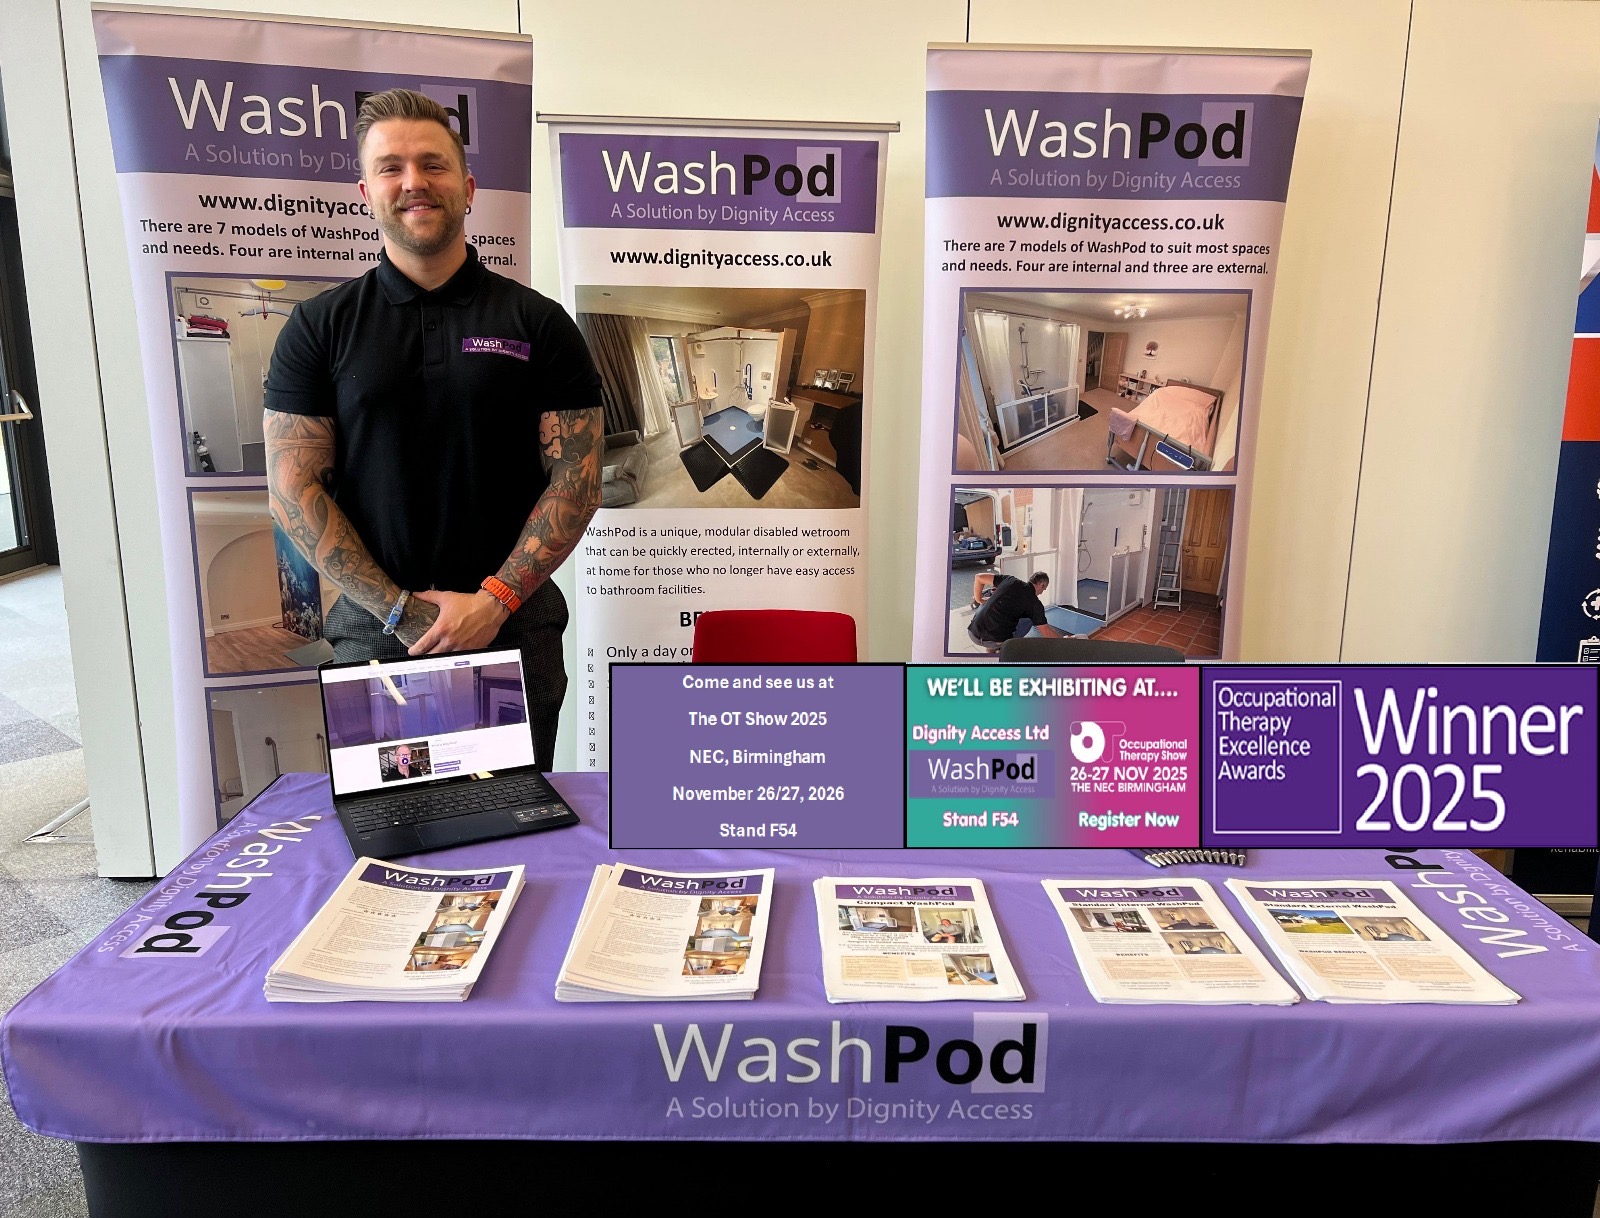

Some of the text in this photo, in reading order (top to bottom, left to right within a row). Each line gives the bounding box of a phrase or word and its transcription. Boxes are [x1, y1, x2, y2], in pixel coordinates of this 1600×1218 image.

[168, 77, 471, 145] Washd
[984, 108, 1246, 159] WashPod
[185, 144, 199, 161] A
[205, 145, 293, 168] Solution
[300, 151, 324, 173] by
[601, 150, 836, 197] WashPod
[990, 168, 1241, 193] A Solution by Dignity Access
[198, 193, 370, 218] www.dignityacc
[610, 203, 835, 226] A Solution by Dignity Access
[140, 219, 379, 241] There are 7 models of WashPod
[997, 212, 1225, 233] www.dignityaccess.co.uk
[471, 234, 515, 247] spaces
[943, 239, 1270, 256] There are 7 models of WashPod to suit most spaces
[142, 241, 168, 254] and
[173, 241, 225, 256] needs.
[229, 243, 264, 257] Four
[268, 247, 293, 258] are
[297, 245, 354, 261] internal
[479, 254, 517, 266] ernal.
[610, 248, 832, 269] www.dignityaccess.co.uk
[942, 259, 1268, 274] and needs. Four are internal and three are external.
[472, 339, 522, 352] WashPod
[586, 526, 850, 538] WashPod is a unique, modular disabled wetroom
[585, 546, 859, 558] that can be quickly erected, internally or externally,
[586, 565, 855, 577] at home for those who no longer have easy access
[587, 585, 705, 595] to bathroom facilities.
[606, 646, 637, 660] Only
[641, 648, 648, 657] a
[653, 645, 677, 659] day
[385, 869, 492, 886] WashPod
[641, 874, 744, 890] WashPod
[140, 877, 197, 913] Dignity
[853, 886, 954, 895] WashPod
[1076, 889, 1180, 898] WashPod
[1264, 889, 1371, 898] WashPod
[1484, 883, 1510, 896] by
[1384, 849, 1549, 958] WashP
[1504, 897, 1571, 941] Solution
[98, 913, 153, 953] Access
[653, 1020, 1037, 1085] WashPod
[666, 1097, 1033, 1124] A Solution by Dignity Access
